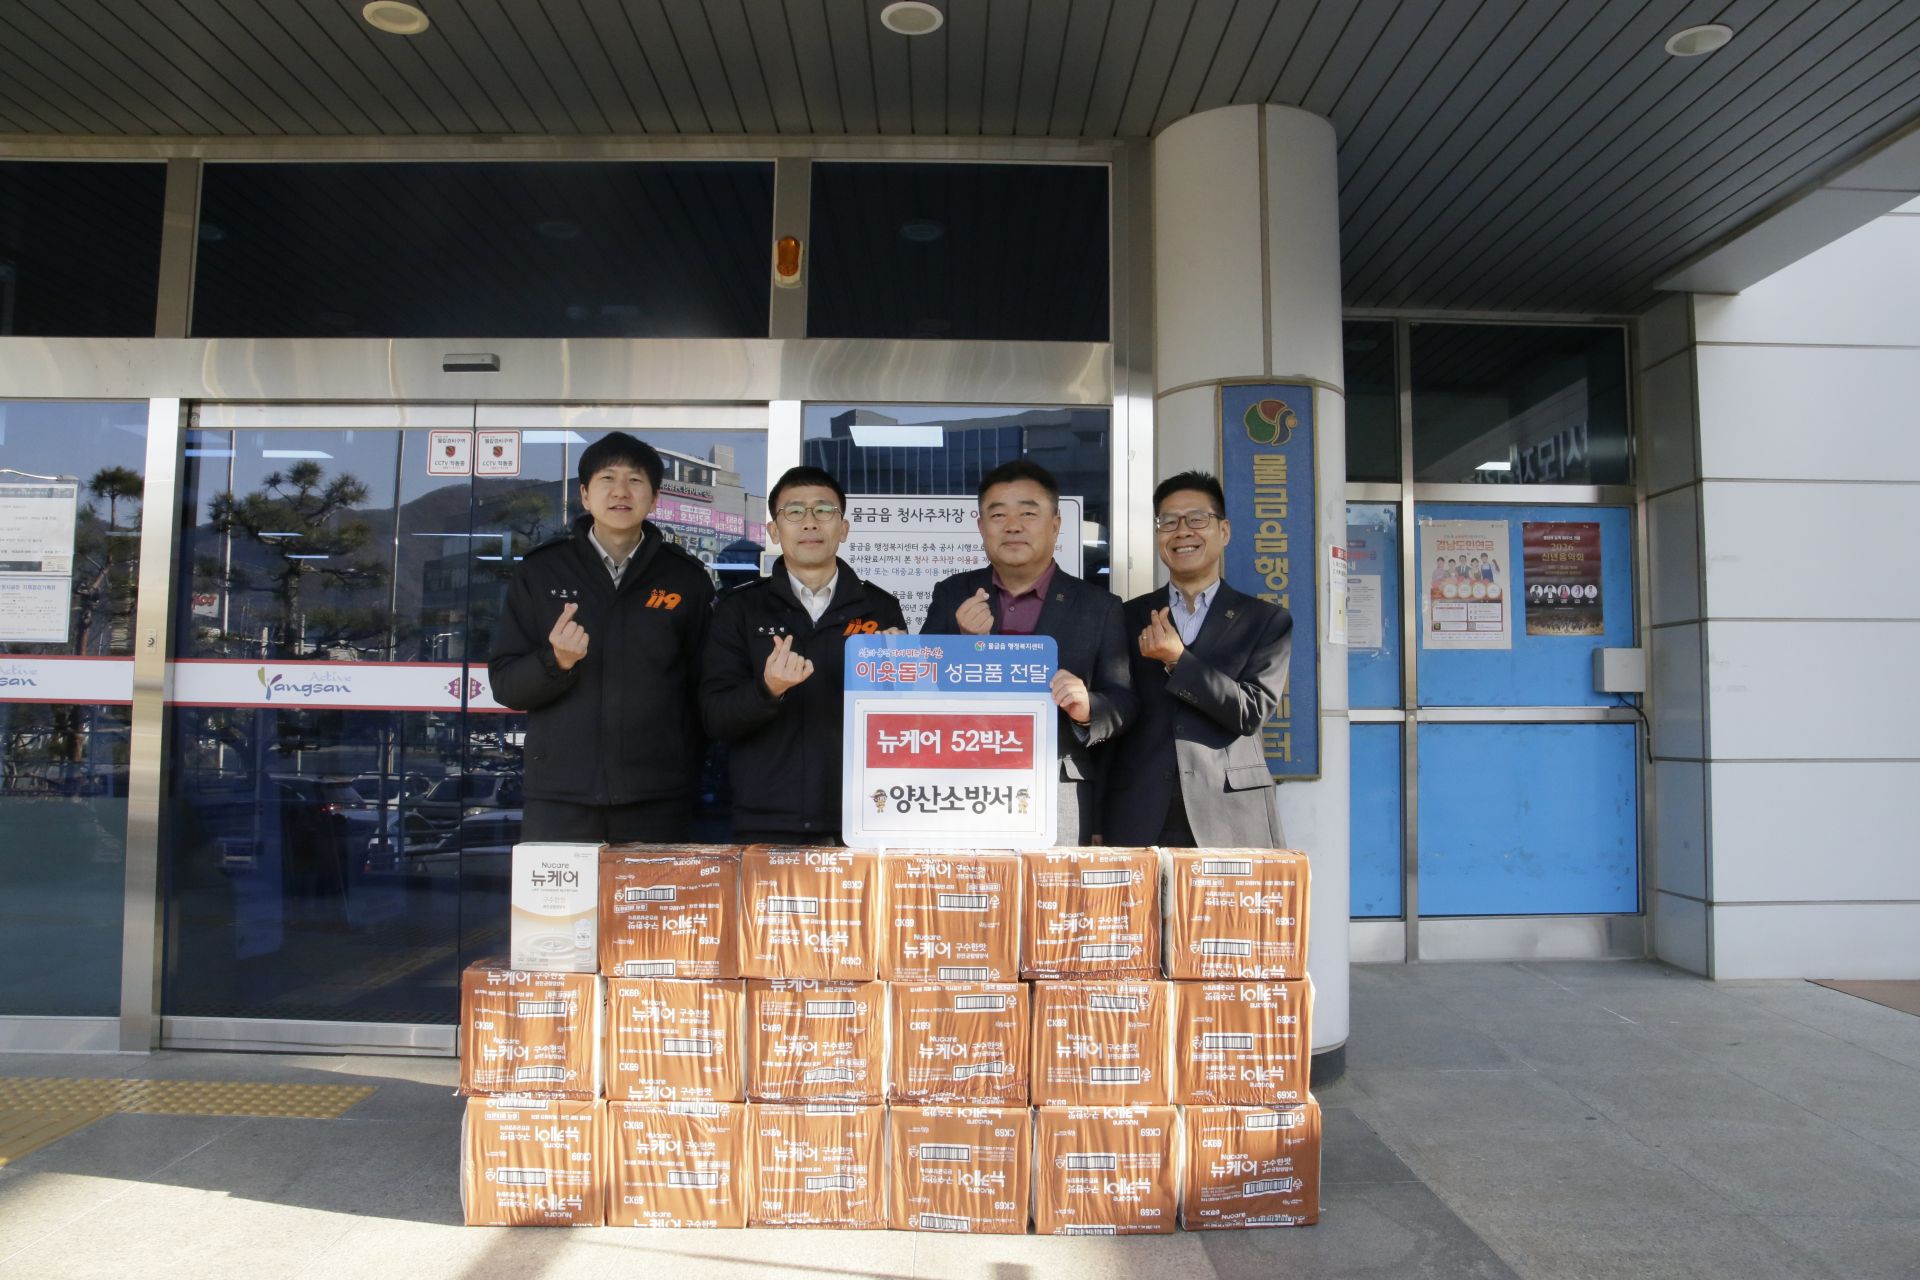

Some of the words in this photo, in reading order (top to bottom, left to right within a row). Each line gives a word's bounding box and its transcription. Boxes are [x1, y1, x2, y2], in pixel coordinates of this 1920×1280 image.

[851, 508, 892, 523] 물금읍
[898, 508, 965, 523] 청사주차장
[849, 543, 871, 551] 물금읍
[874, 543, 918, 551] 행정복지센터
[940, 544, 954, 552] 공사
[1552, 543, 1574, 551] 2026
[904, 556, 911, 564] 본
[914, 556, 929, 564] 청사
[932, 556, 953, 564] 주차장
[957, 556, 979, 564] 이용을
[853, 567, 871, 576] 차장
[874, 567, 888, 575] 또는
[892, 568, 922, 576] 대중교통
[925, 568, 939, 576] 이용
[645, 593, 682, 610] 119
[916, 591, 933, 599] 행정
[310, 671, 352, 682] Active
[856, 662, 938, 683] 이웃돕기
[945, 663, 1003, 683] 성금품
[1010, 664, 1049, 683] 전달
[877, 730, 940, 754] 뉴케어
[951, 730, 1024, 754] 52박스
[889, 785, 1013, 814] 양산소방서
[701, 866, 720, 876] CK69
[907, 864, 951, 878] 뉴케어
[531, 870, 578, 887] 뉴케어
[1038, 901, 1057, 909] CK69
[1240, 892, 1283, 907] 뉴케어
[663, 914, 707, 930] 뉴케어
[1049, 918, 1093, 933] 뉴케어
[1276, 918, 1295, 926] CK69
[804, 930, 848, 947] 뉴케어
[904, 942, 950, 959] 뉴케어
[956, 943, 986, 951] 구수한맛
[487, 971, 530, 985] 뉴케어
[1241, 985, 1287, 1001] 뉴케어
[632, 1007, 675, 1023] 뉴케어
[1277, 1016, 1296, 1024] CK69
[910, 1022, 930, 1030] CK69
[1047, 1019, 1067, 1027] CK69
[484, 1044, 528, 1061] 뉴케어
[774, 1042, 817, 1056] 뉴케어
[919, 1044, 968, 1059] 뉴케어
[1057, 1042, 1102, 1058] 뉴케어
[619, 1063, 639, 1071] CK69
[1241, 1066, 1284, 1081] 뉴케어
[628, 1086, 675, 1100] 뉴케어
[681, 1088, 712, 1096] 구수한맛
[1277, 1091, 1297, 1099] CK69
[624, 1121, 643, 1129] CK69
[1140, 1128, 1160, 1136] CK69
[535, 1126, 579, 1142] 뉴케어
[995, 1129, 1015, 1137] CK69
[636, 1139, 680, 1155] 뉴케어
[1203, 1139, 1222, 1147] CK69
[775, 1146, 817, 1161] 뉴케어
[1211, 1161, 1257, 1178] 뉴케어
[1262, 1158, 1291, 1167] 구수한맛
[958, 1170, 1005, 1187] 뉴케어
[1104, 1178, 1151, 1194] 뉴케어
[535, 1194, 582, 1210] 뉴케어
[624, 1196, 643, 1204] CK69
[995, 1202, 1015, 1210] CK69
